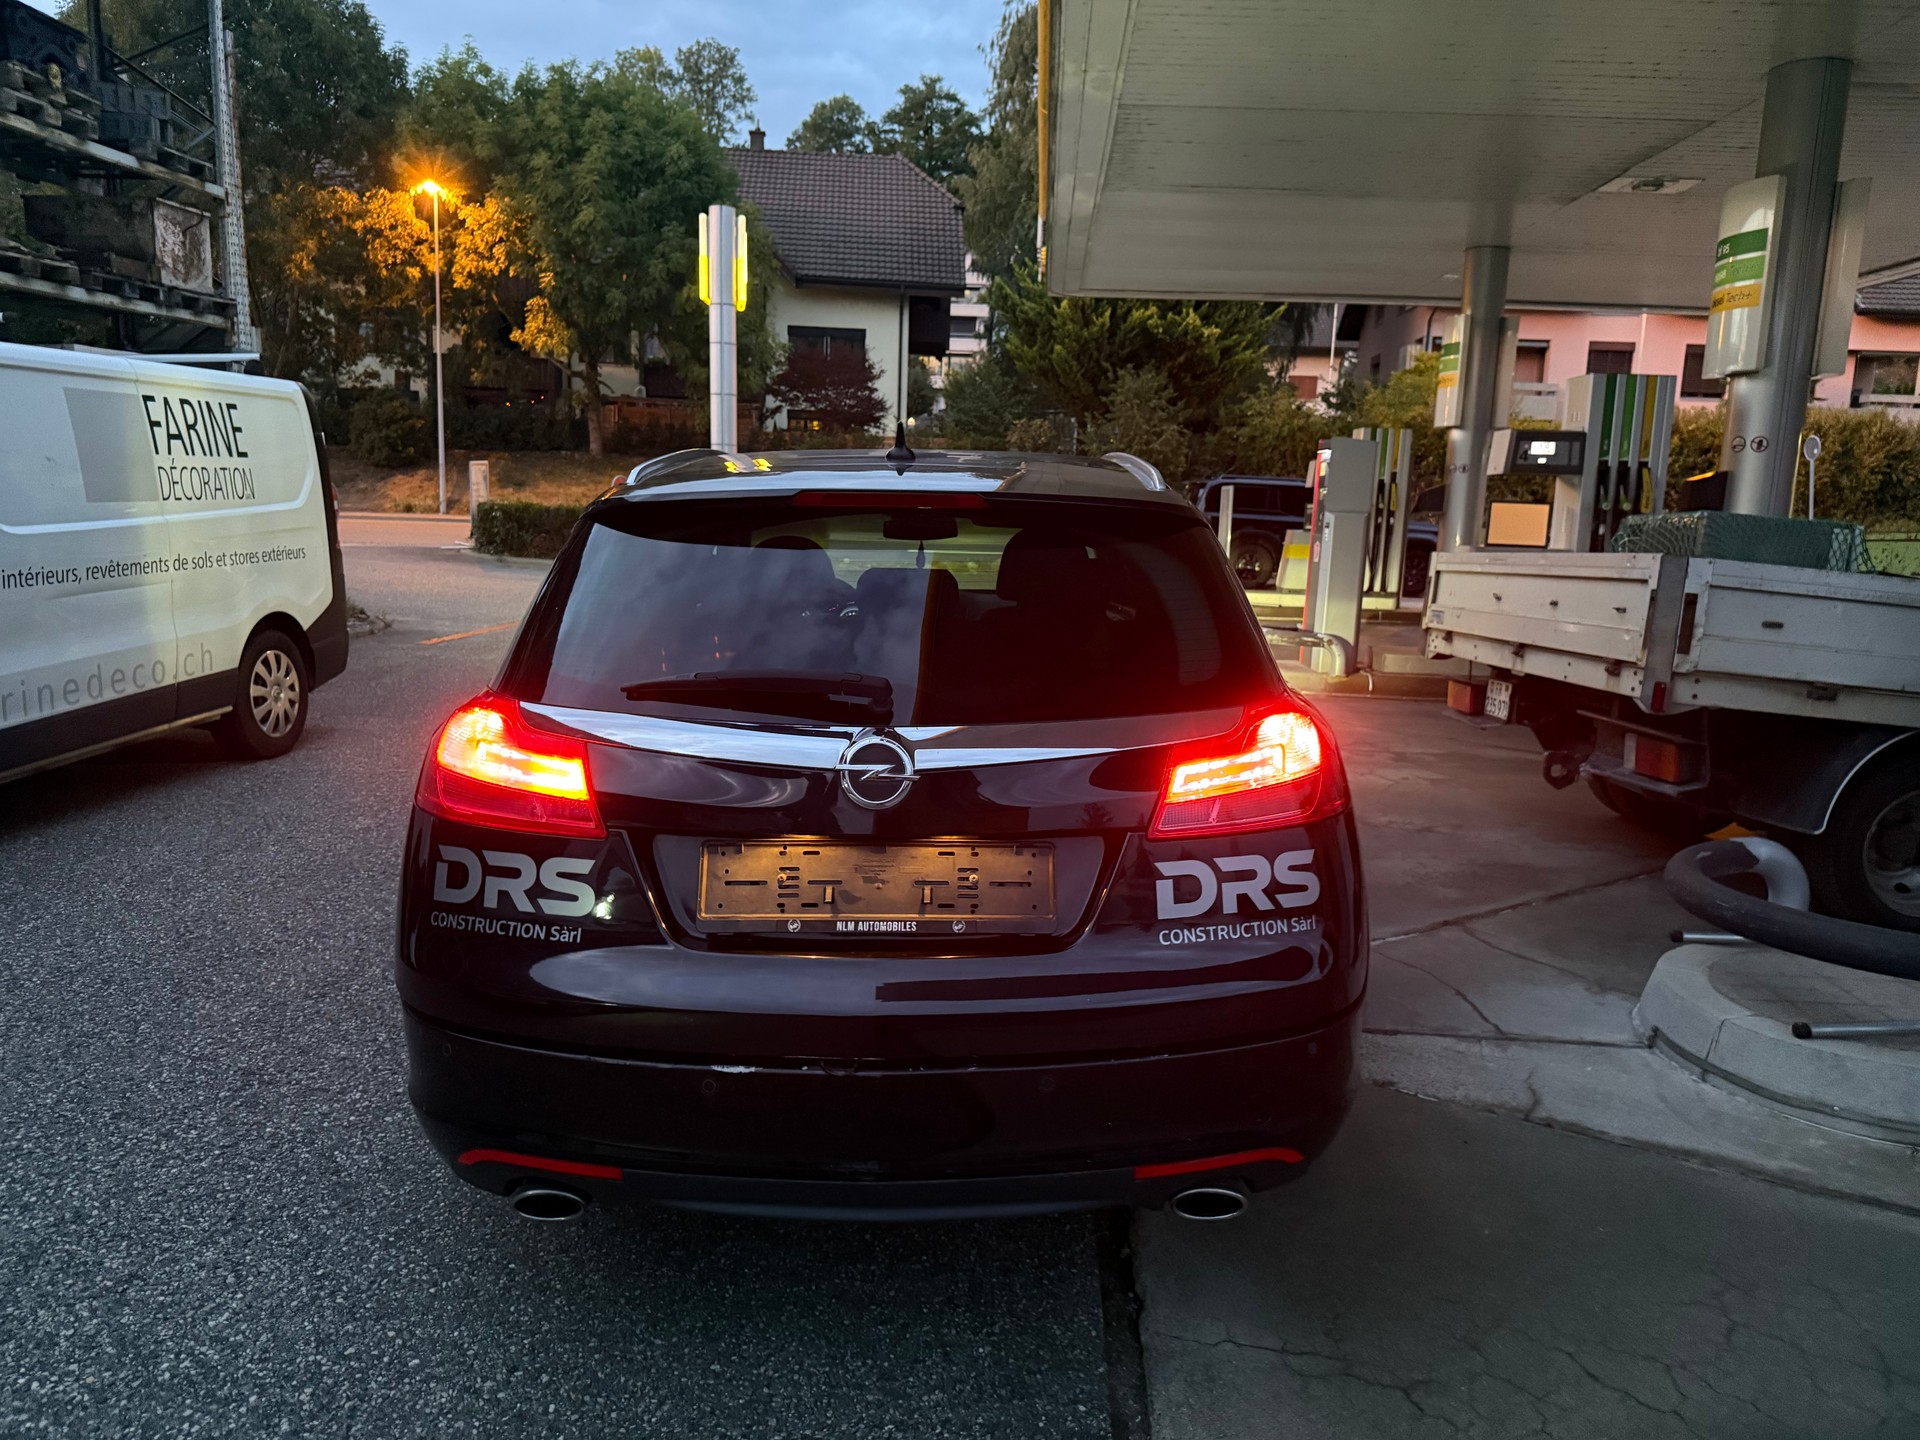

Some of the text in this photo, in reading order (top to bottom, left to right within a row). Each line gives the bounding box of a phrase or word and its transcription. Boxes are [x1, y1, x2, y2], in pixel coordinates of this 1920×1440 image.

[141, 394, 249, 458] FARINE
[157, 458, 256, 501] DÉCORATION
[1, 545, 306, 589] intérieurs, revêtements de sols et stores extérieurs
[433, 845, 597, 917] DRS
[1153, 849, 1321, 920] DRS
[430, 911, 546, 940] CONSTRUCTION
[836, 921, 917, 932] NLM AUTOMOBILES
[1158, 919, 1288, 945] CONSTRUCTION
